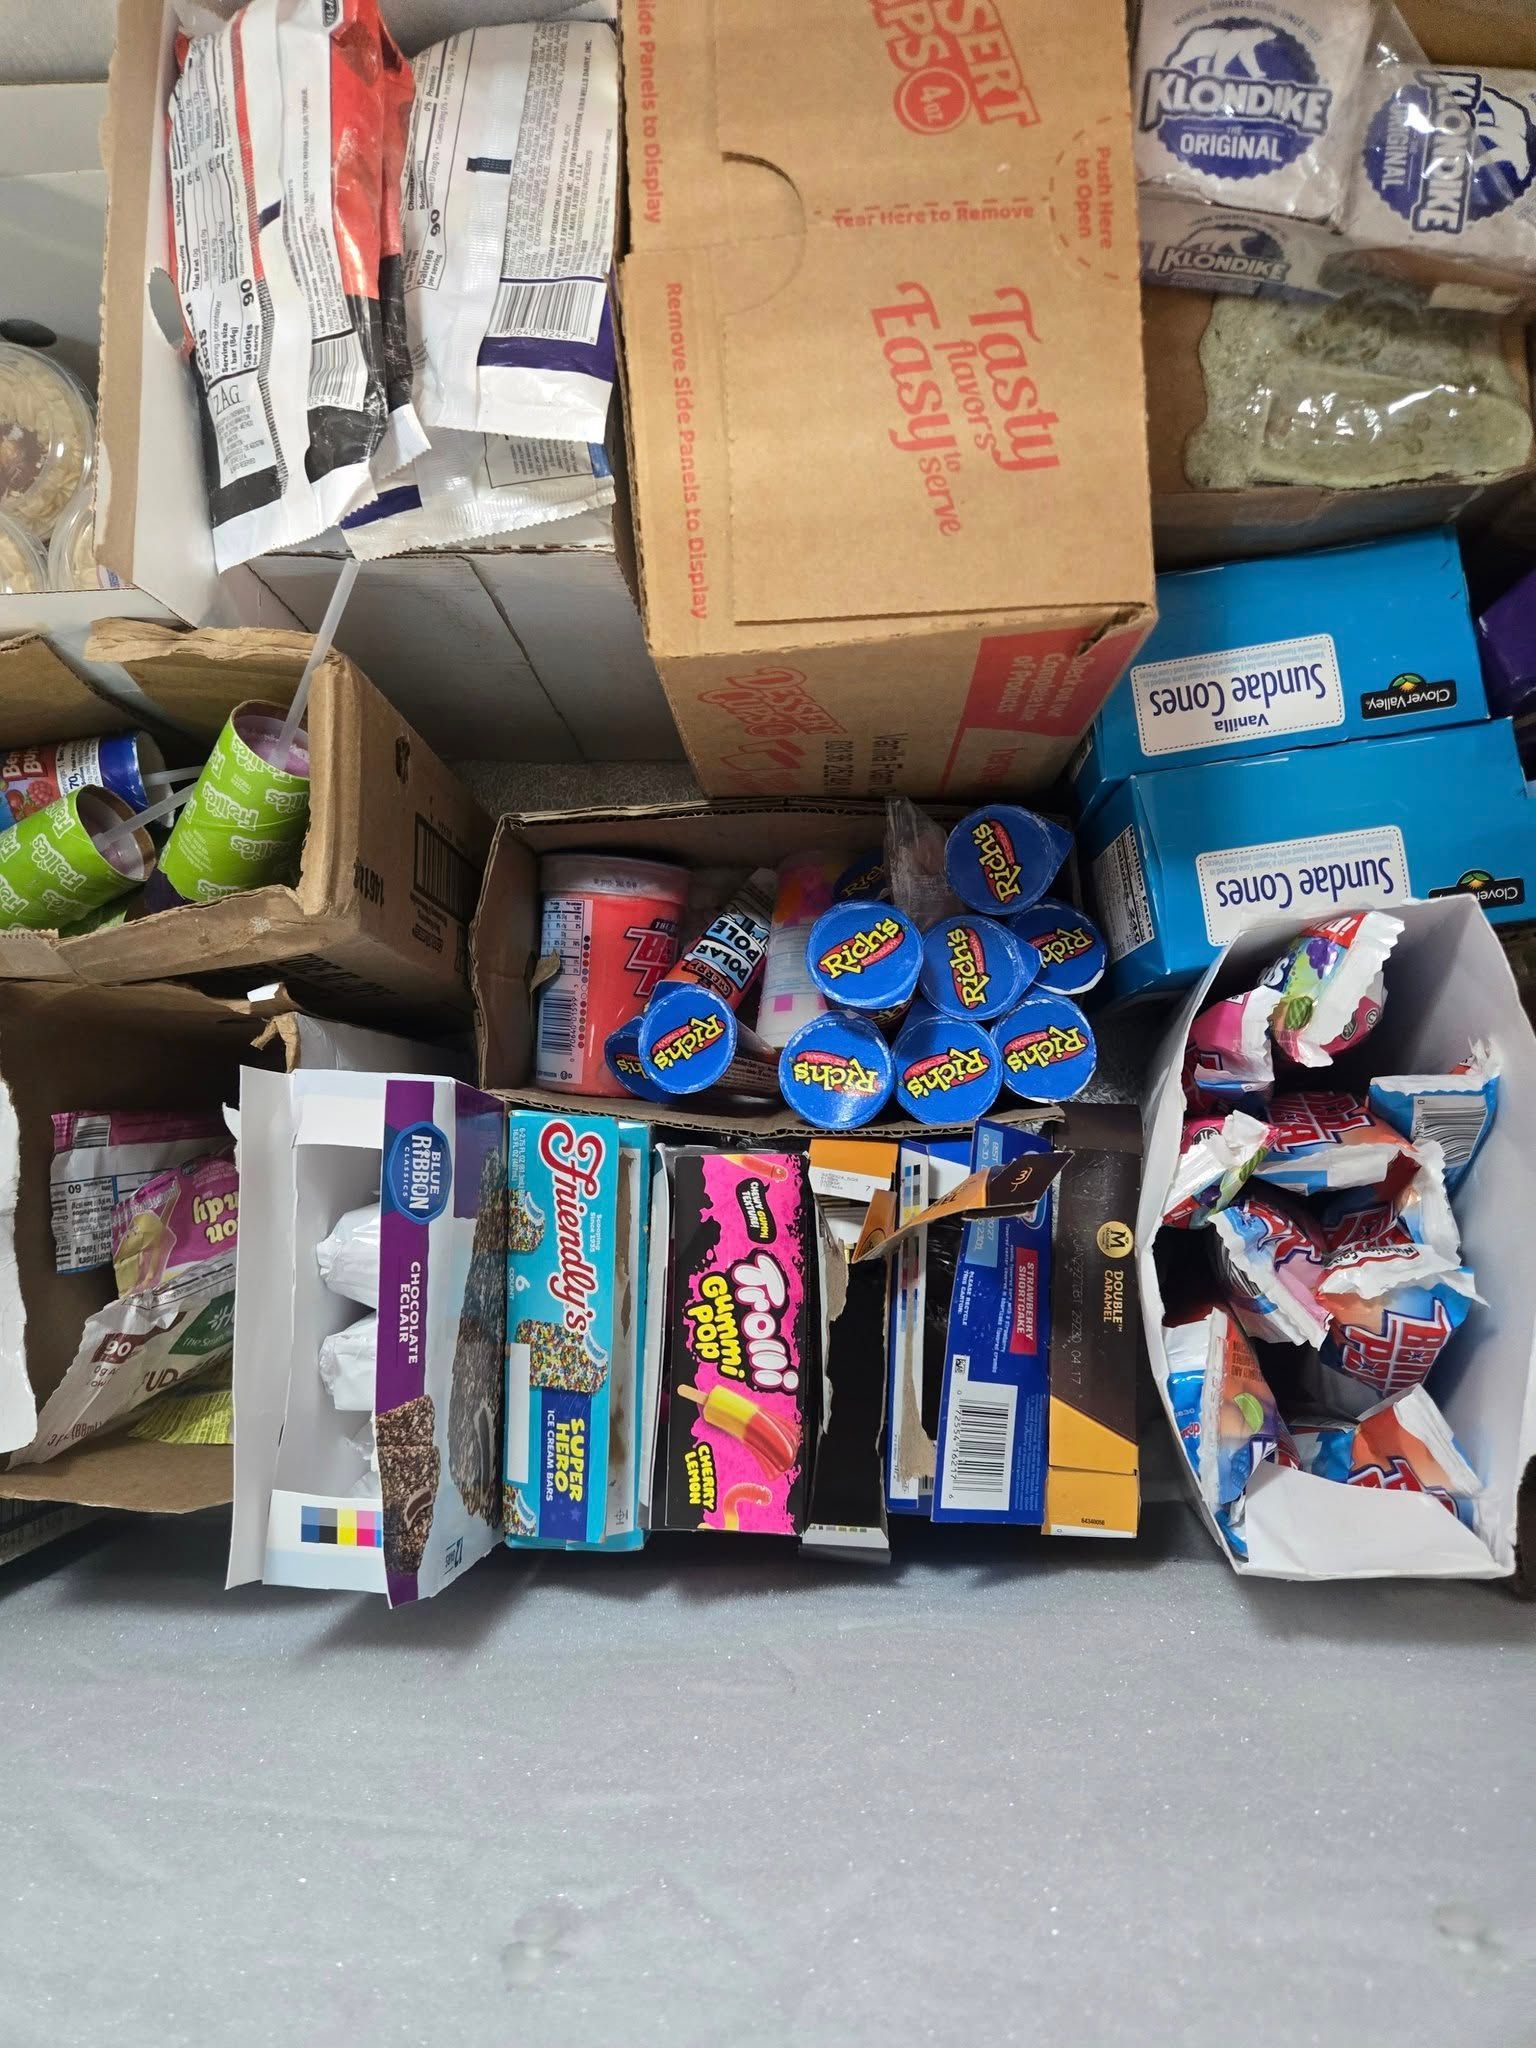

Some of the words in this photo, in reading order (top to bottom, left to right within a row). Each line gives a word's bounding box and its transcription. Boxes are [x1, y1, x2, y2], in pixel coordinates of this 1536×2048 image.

[640, 41, 657, 110] Panels
[1141, 70, 1329, 133] KLONDIKE
[643, 116, 657, 138] to
[1180, 136, 1283, 163] ORIGINAL
[1075, 158, 1090, 178] to
[1097, 146, 1112, 195] Push
[1418, 73, 1477, 231] KLONDIKE
[643, 143, 663, 224] Display
[430, 209, 441, 237] 90
[931, 208, 950, 222] to
[957, 204, 1034, 222] Remove
[1074, 185, 1092, 238] Open
[1099, 202, 1113, 250] Here
[417, 249, 435, 286] Calories
[1160, 247, 1289, 281] KLONDIKE
[240, 279, 254, 307] 90
[243, 324, 254, 368] Calories
[666, 282, 686, 372] Remove
[674, 376, 693, 424] Side
[934, 338, 997, 453] flavors
[969, 286, 1060, 471] Tasty
[871, 282, 957, 451] Easy
[919, 457, 962, 537] serve
[679, 429, 700, 503] Panels
[686, 508, 700, 532] to
[688, 537, 709, 620] Display
[1150, 679, 1226, 717] Cones
[1232, 663, 1328, 709] Sundae
[1214, 712, 1269, 733] Vanilla
[972, 822, 1022, 902] Rich's
[1299, 857, 1395, 903] Sundae
[1215, 878, 1294, 909] Cones
[698, 943, 750, 985] POLAR
[710, 919, 763, 963] POLE
[820, 917, 901, 981] Rich's
[1042, 927, 1094, 969] Rich
[948, 928, 990, 1007] Rich's
[653, 1013, 725, 1071] Rich's
[1006, 1025, 1087, 1074] Rich's
[793, 1057, 878, 1096] Rich's
[907, 1047, 989, 1099] Rich's
[68, 1184, 82, 1195] 60
[409, 1134, 433, 1210] RIBBON
[430, 1151, 441, 1195] BLUE
[540, 1121, 605, 1333] Friendly's
[741, 1190, 759, 1228] TEXTURE!
[750, 1182, 763, 1209] CHEWY
[757, 1210, 770, 1239] GUMMI
[1369, 1243, 1419, 1262] Nutrition
[514, 1275, 531, 1292] 6
[1016, 1266, 1027, 1335] SHORTCAKE
[1025, 1261, 1036, 1341] STRAWBERRY
[1103, 1269, 1114, 1323] CARAMEL
[399, 1283, 411, 1343] ECLAIR
[409, 1261, 421, 1364] CHOCOLATE
[734, 1254, 799, 1390] Trolli
[105, 1340, 132, 1358] 90
[547, 1410, 555, 1427] ICE
[546, 1430, 555, 1470] CREAM
[554, 1422, 570, 1492] HERO
[569, 1418, 585, 1502] SUPER
[545, 1472, 554, 1502] BARS
[684, 1451, 702, 1505] LEMON
[698, 1444, 716, 1510] CHERRY
